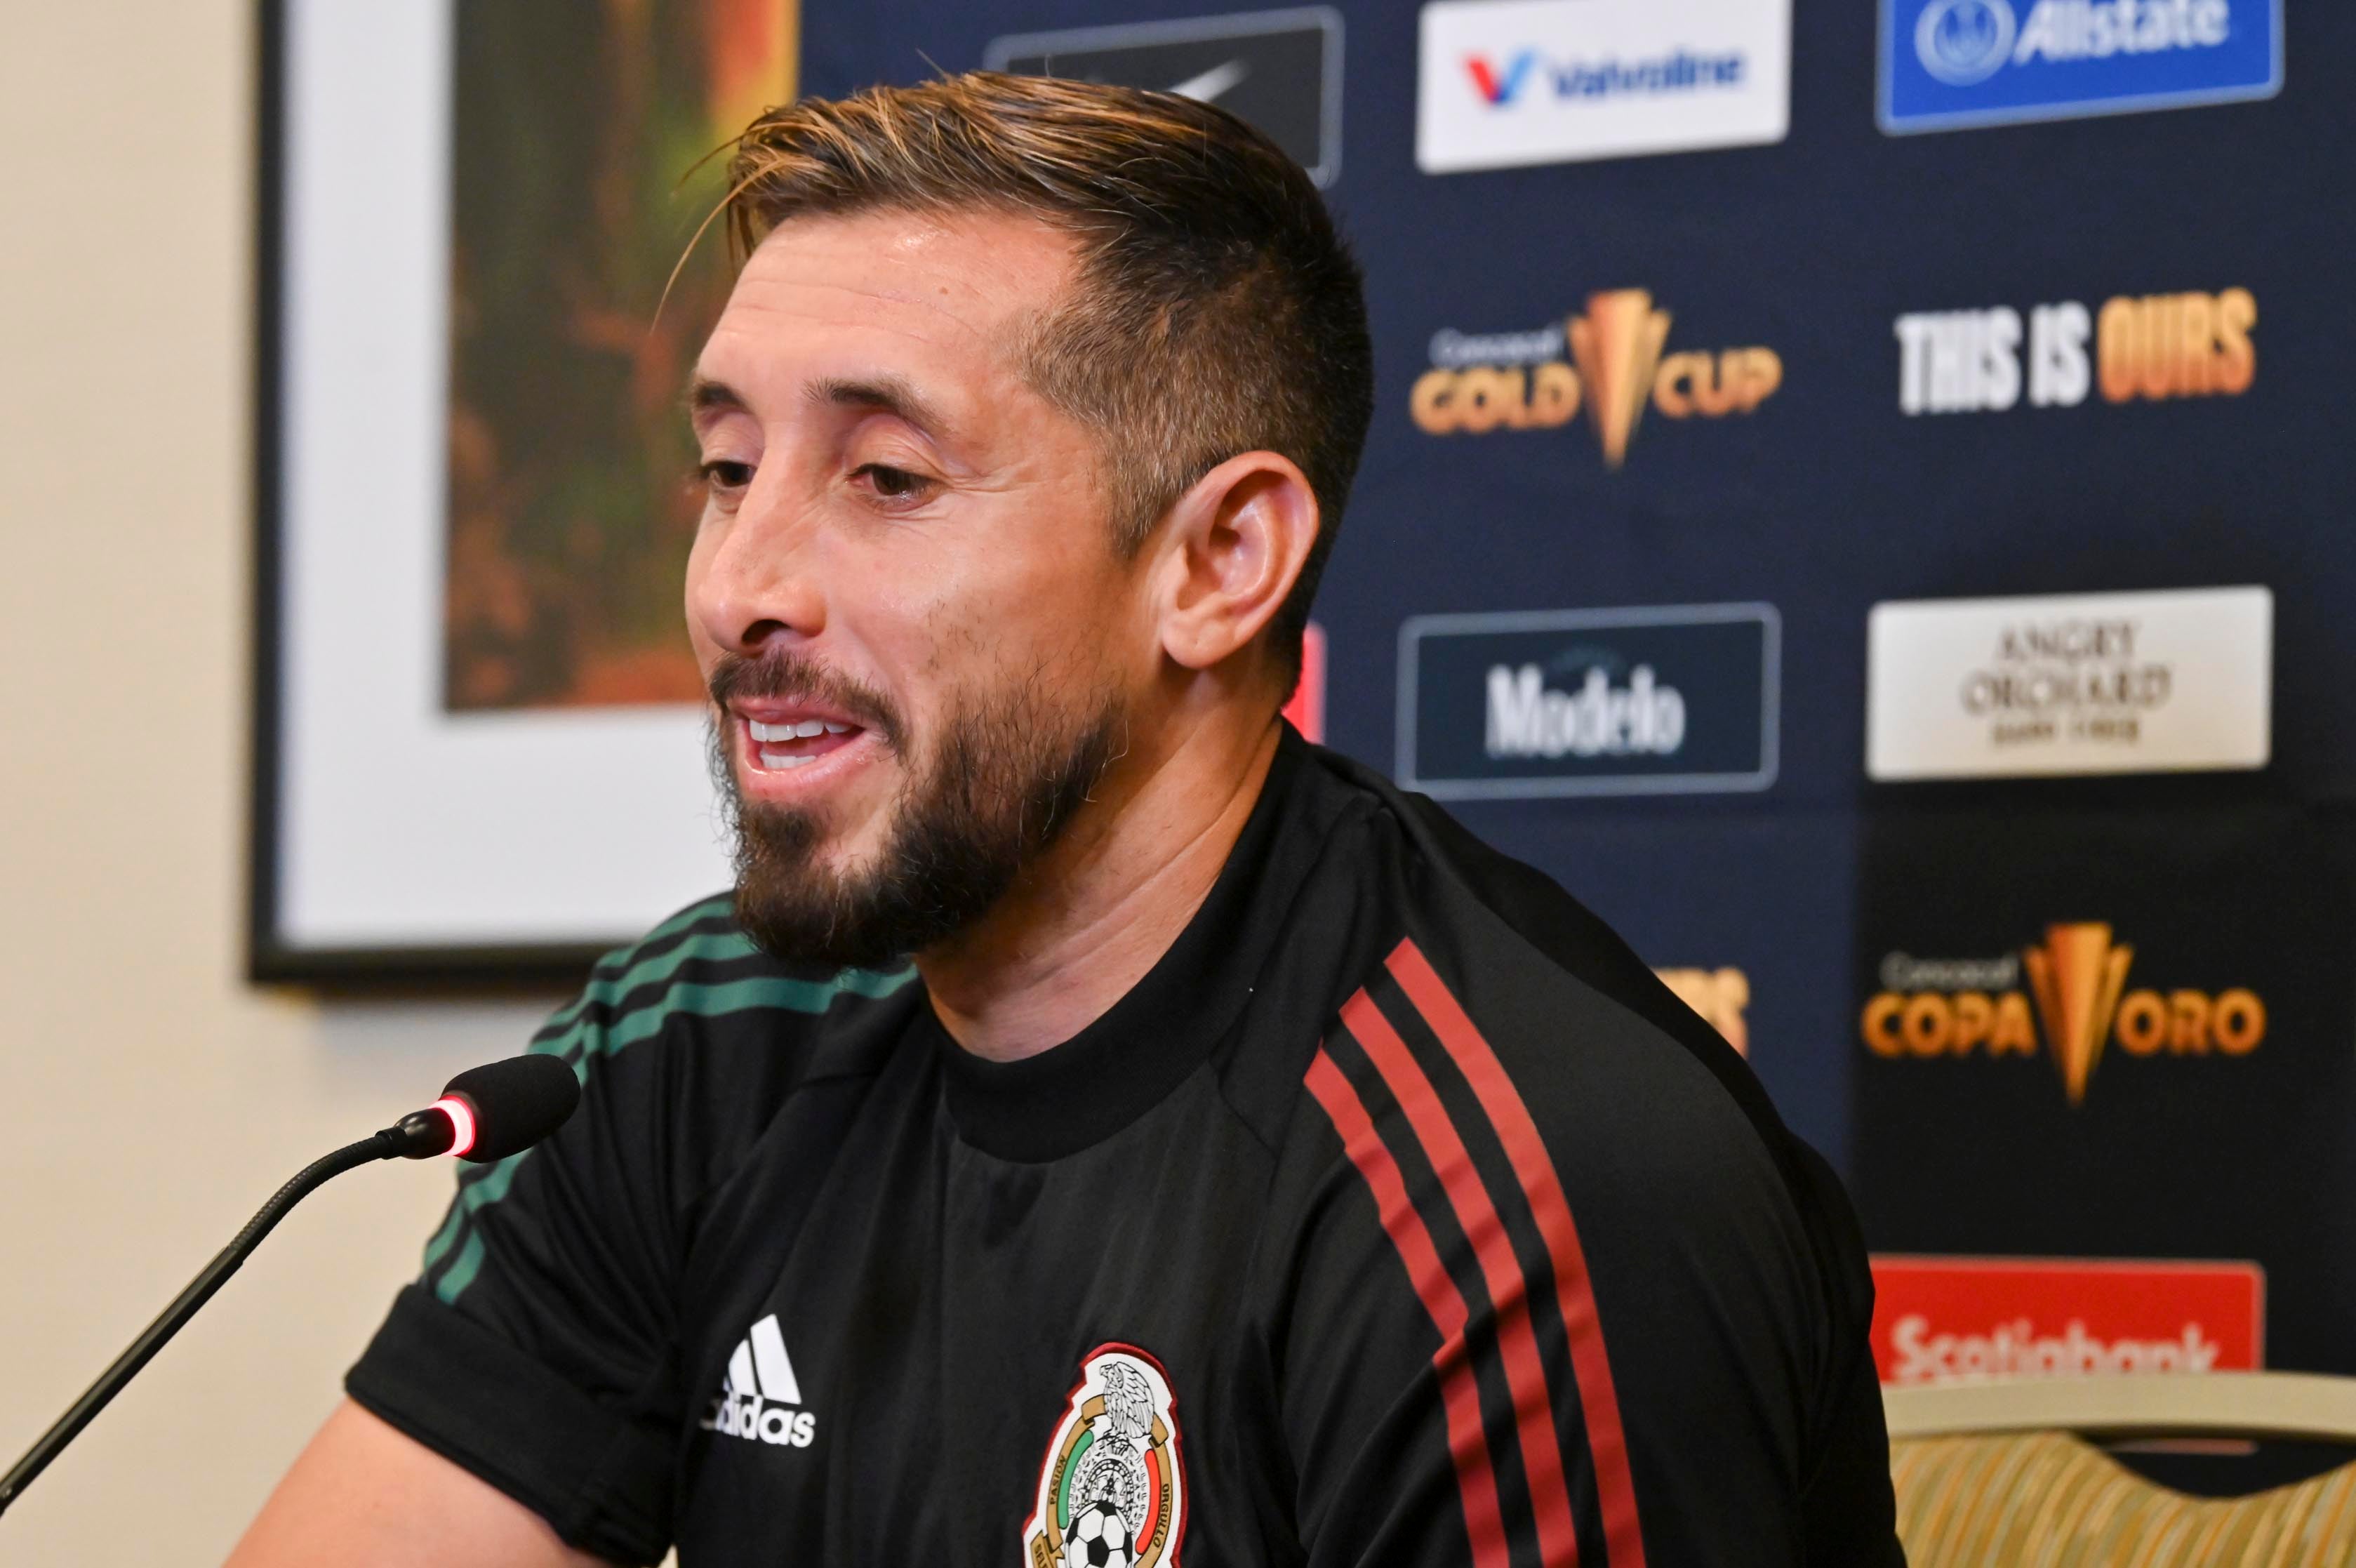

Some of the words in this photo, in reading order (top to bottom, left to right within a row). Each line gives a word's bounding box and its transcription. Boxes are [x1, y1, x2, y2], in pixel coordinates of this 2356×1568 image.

[2011, 0, 2229, 66] Allstate
[1549, 48, 1745, 102] Valvoline
[1896, 306, 2022, 415] THIS
[2029, 301, 2091, 407] IS
[2097, 287, 2257, 404] OURS
[1410, 361, 1582, 434] GOLD
[1653, 347, 1783, 418] CUP
[1995, 621, 2138, 665] ANGRY
[1486, 664, 1686, 759] Modelo
[1962, 665, 2172, 715] ORCHARD
[1863, 990, 2037, 1057] COPA
[2115, 988, 2268, 1056] ORO
[1890, 1314, 2223, 1385] Scotiabank
[1153, 1483, 1170, 1548] ORGULLO
